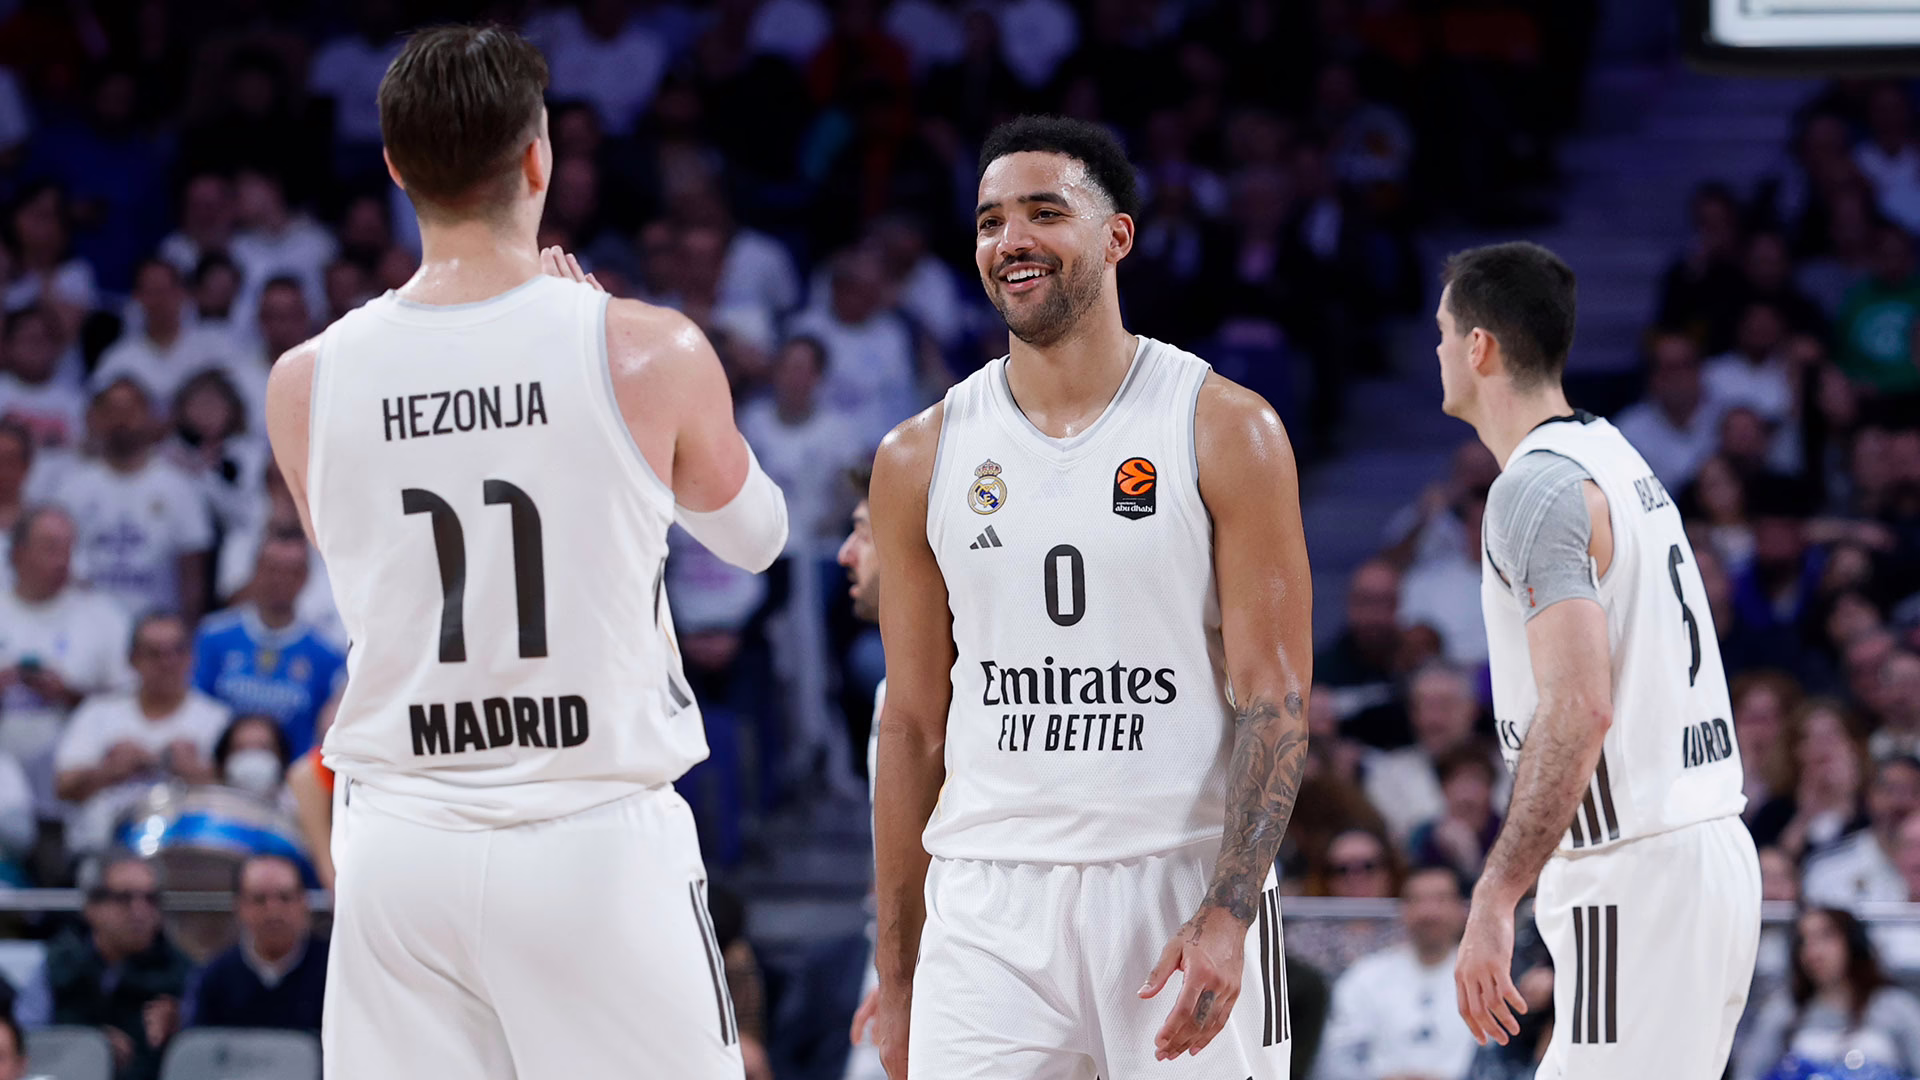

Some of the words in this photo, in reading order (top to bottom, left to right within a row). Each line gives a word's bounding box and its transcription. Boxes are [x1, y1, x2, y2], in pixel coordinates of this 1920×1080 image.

[383, 381, 548, 442] HEZONJA
[1115, 504, 1130, 512] abu
[1131, 504, 1153, 513] dhabi
[402, 479, 548, 663] 11
[1044, 544, 1086, 626] 0
[980, 656, 1177, 706] Emirates
[408, 694, 590, 757] MADRID
[998, 714, 1036, 752] FLY
[1045, 713, 1145, 752] BETTER
